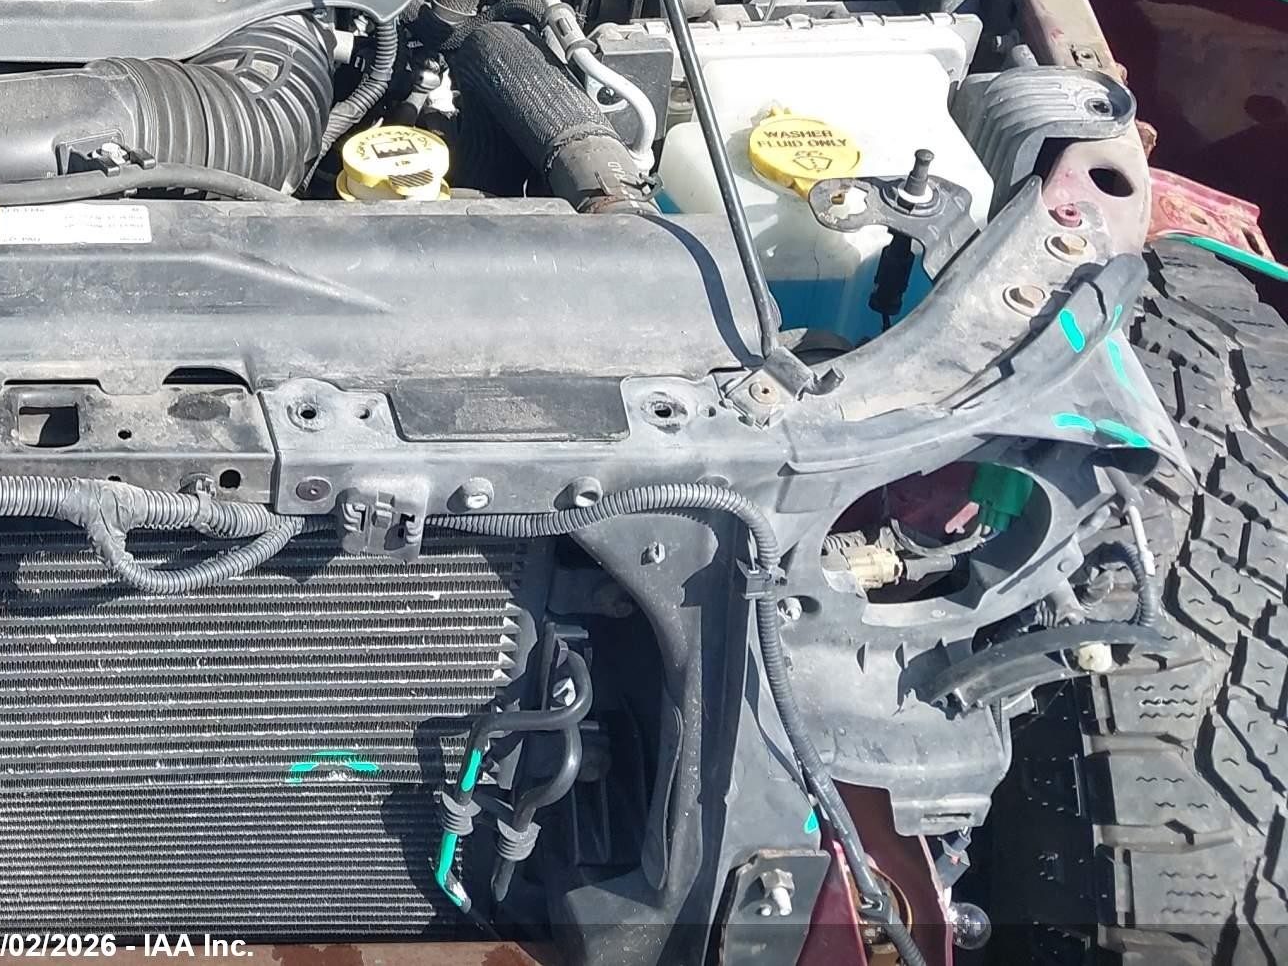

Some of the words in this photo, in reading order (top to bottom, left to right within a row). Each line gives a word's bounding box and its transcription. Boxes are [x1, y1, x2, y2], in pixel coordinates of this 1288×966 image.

[763, 129, 833, 139] WASHER
[757, 139, 803, 148] FLUID
[807, 138, 848, 148] ONLY
